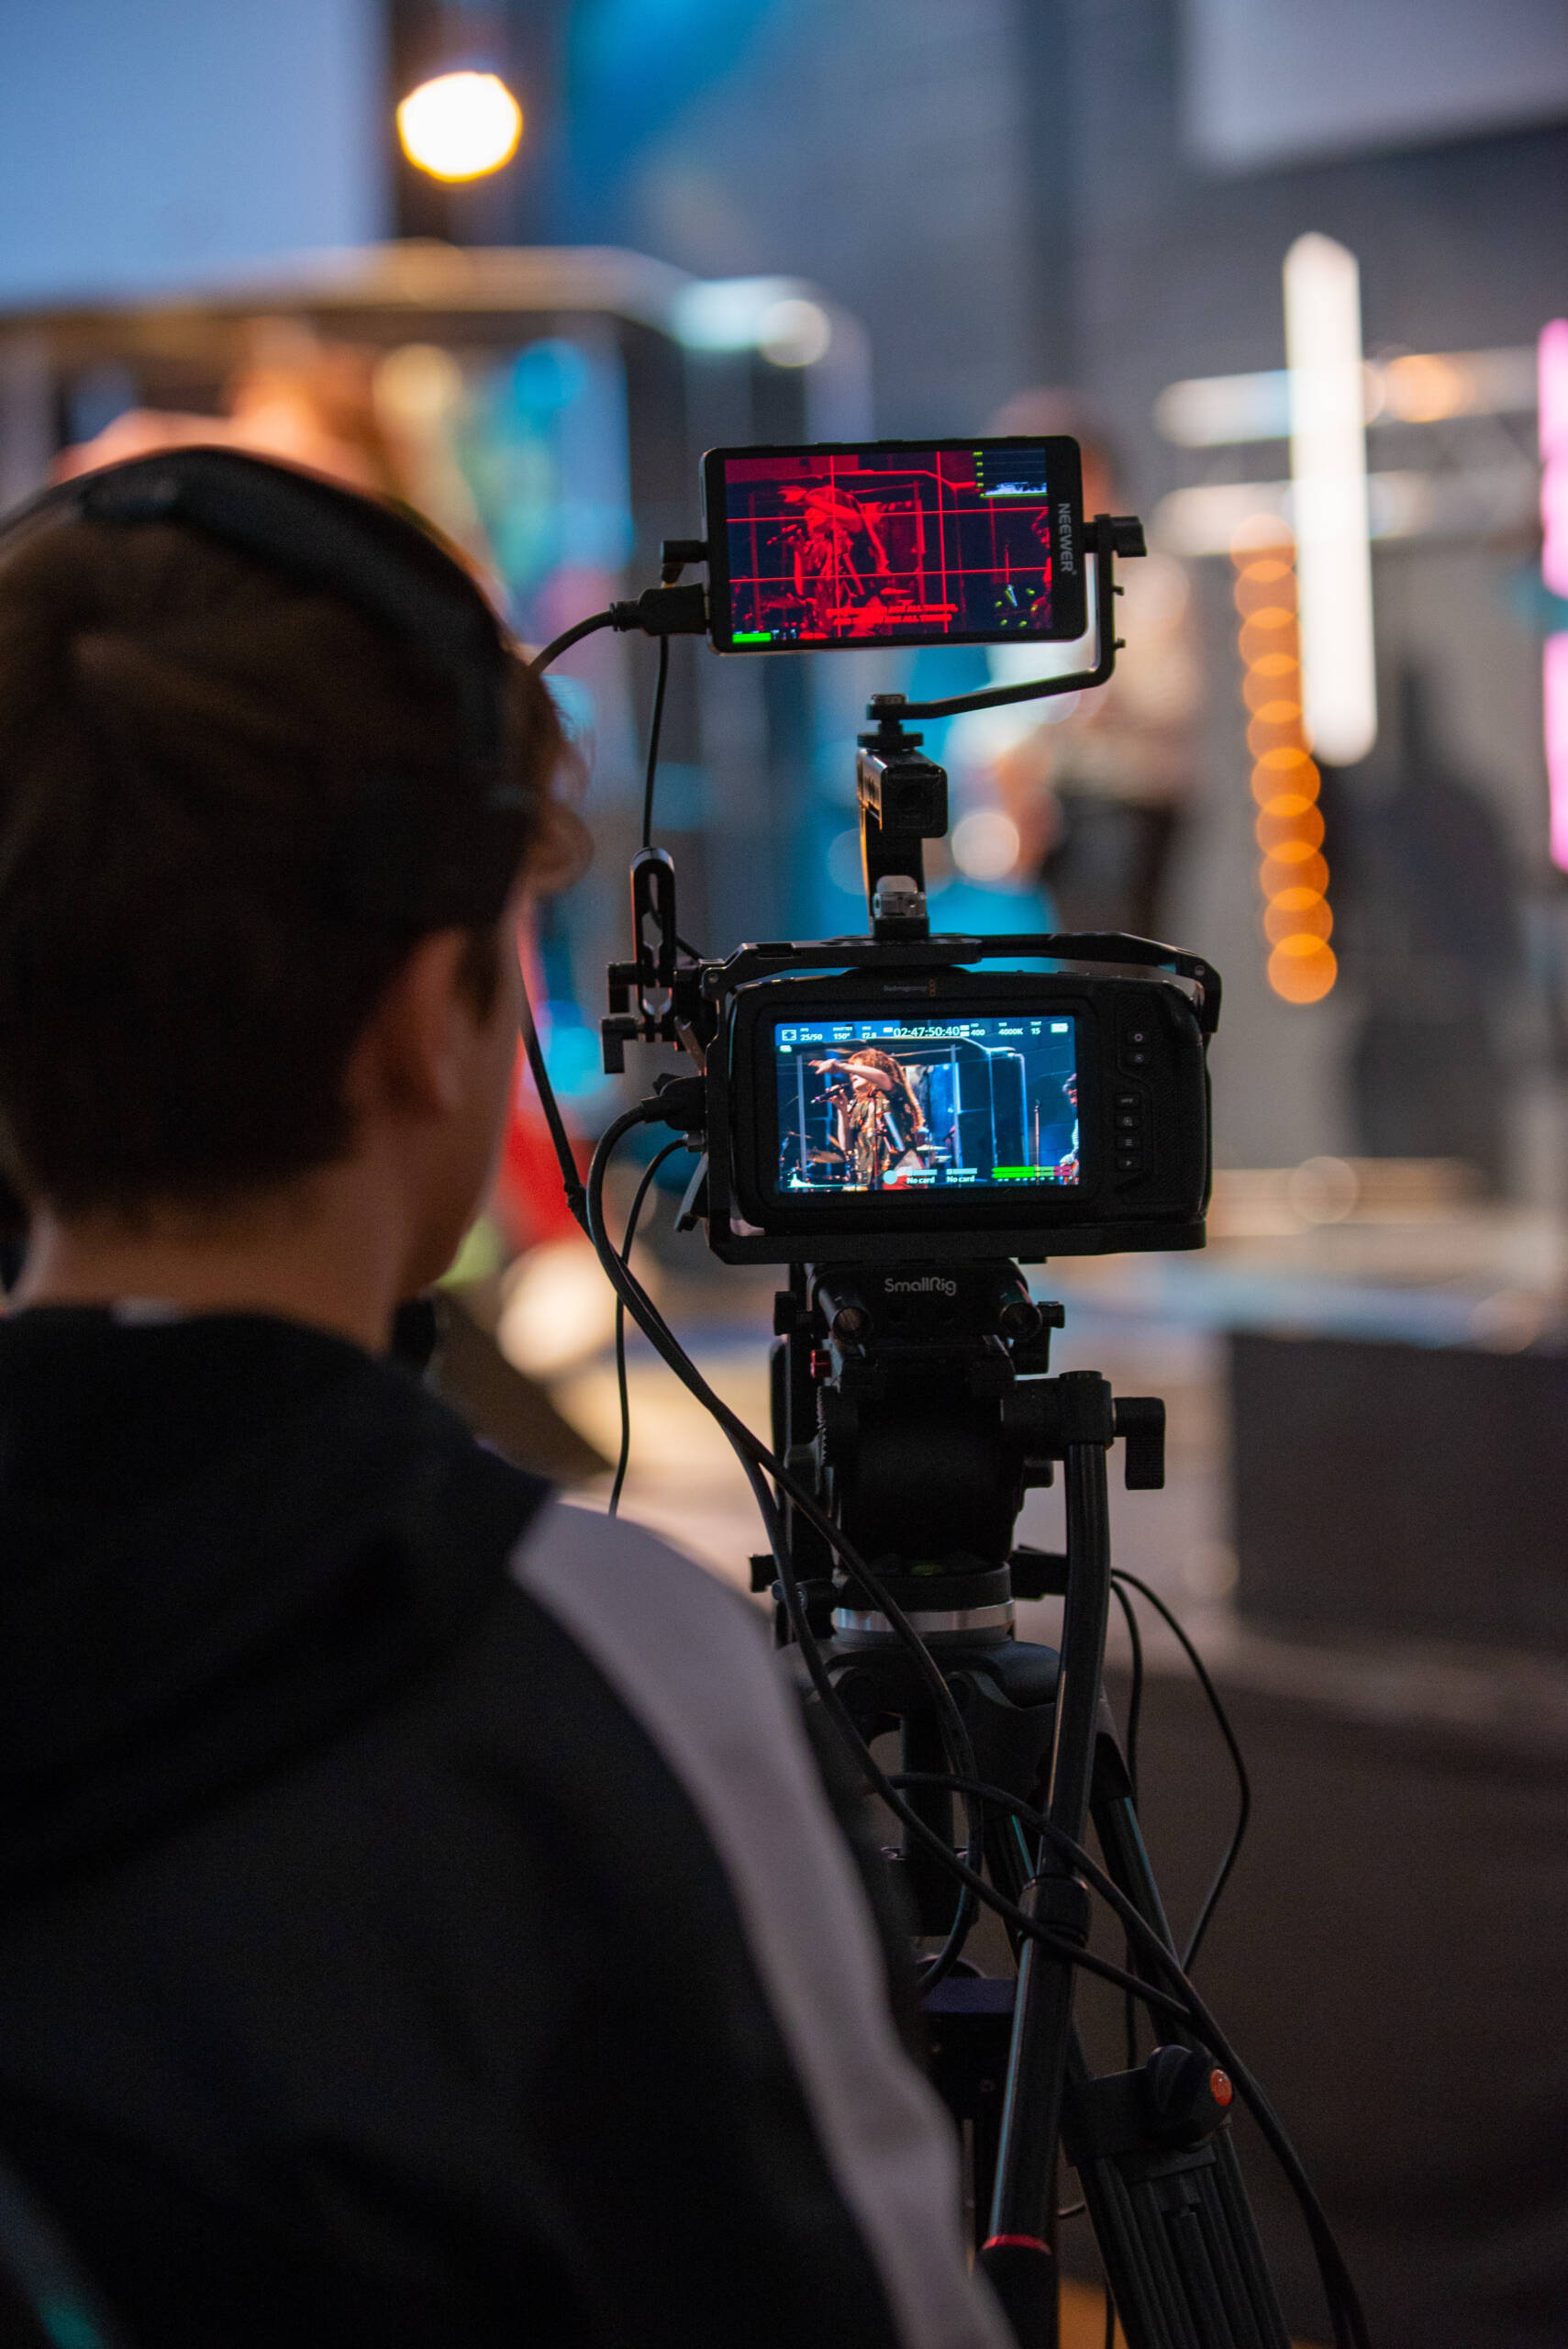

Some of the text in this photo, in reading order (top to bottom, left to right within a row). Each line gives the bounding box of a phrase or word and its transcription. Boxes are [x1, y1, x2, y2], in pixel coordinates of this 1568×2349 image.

[1058, 503, 1073, 572] NEEWER
[894, 1026, 961, 1038] 02:47:50:40
[998, 1028, 1024, 1036] 4000K
[1031, 1027, 1041, 1035] 15
[906, 1175, 936, 1185] No card
[947, 1174, 975, 1184] No card
[884, 1276, 957, 1297] SmallRig
